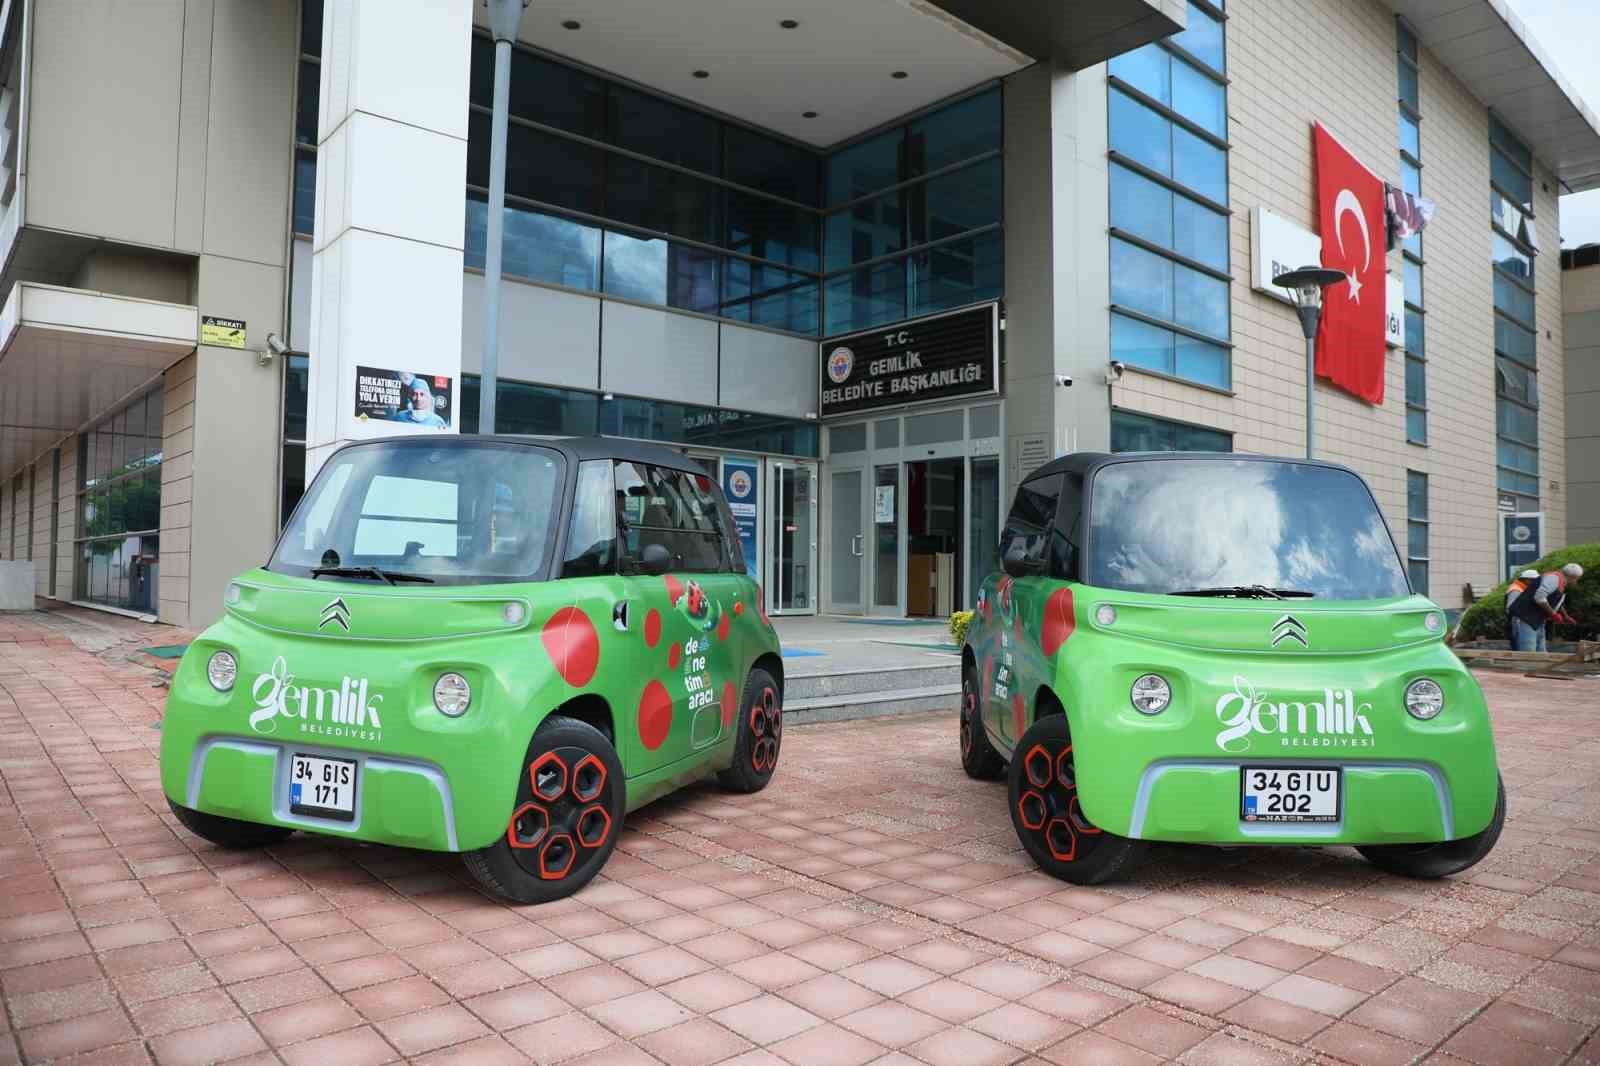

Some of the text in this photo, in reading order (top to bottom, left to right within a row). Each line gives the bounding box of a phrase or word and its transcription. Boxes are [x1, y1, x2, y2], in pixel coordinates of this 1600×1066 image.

[869, 351, 922, 376] GEMLİK
[822, 363, 982, 404] BELEDİYE BAŞKANLIĞI
[685, 636, 698, 655] de
[693, 656, 706, 673] ne
[684, 674, 704, 692] tim
[249, 668, 384, 734] gemlik
[1215, 686, 1374, 752] gemlik
[301, 722, 382, 742] BELEDİYESİ
[1281, 736, 1375, 747] BELEDİYESİ
[296, 761, 350, 785] 34 GIS
[315, 785, 338, 805] 171
[1267, 793, 1312, 813] 202
